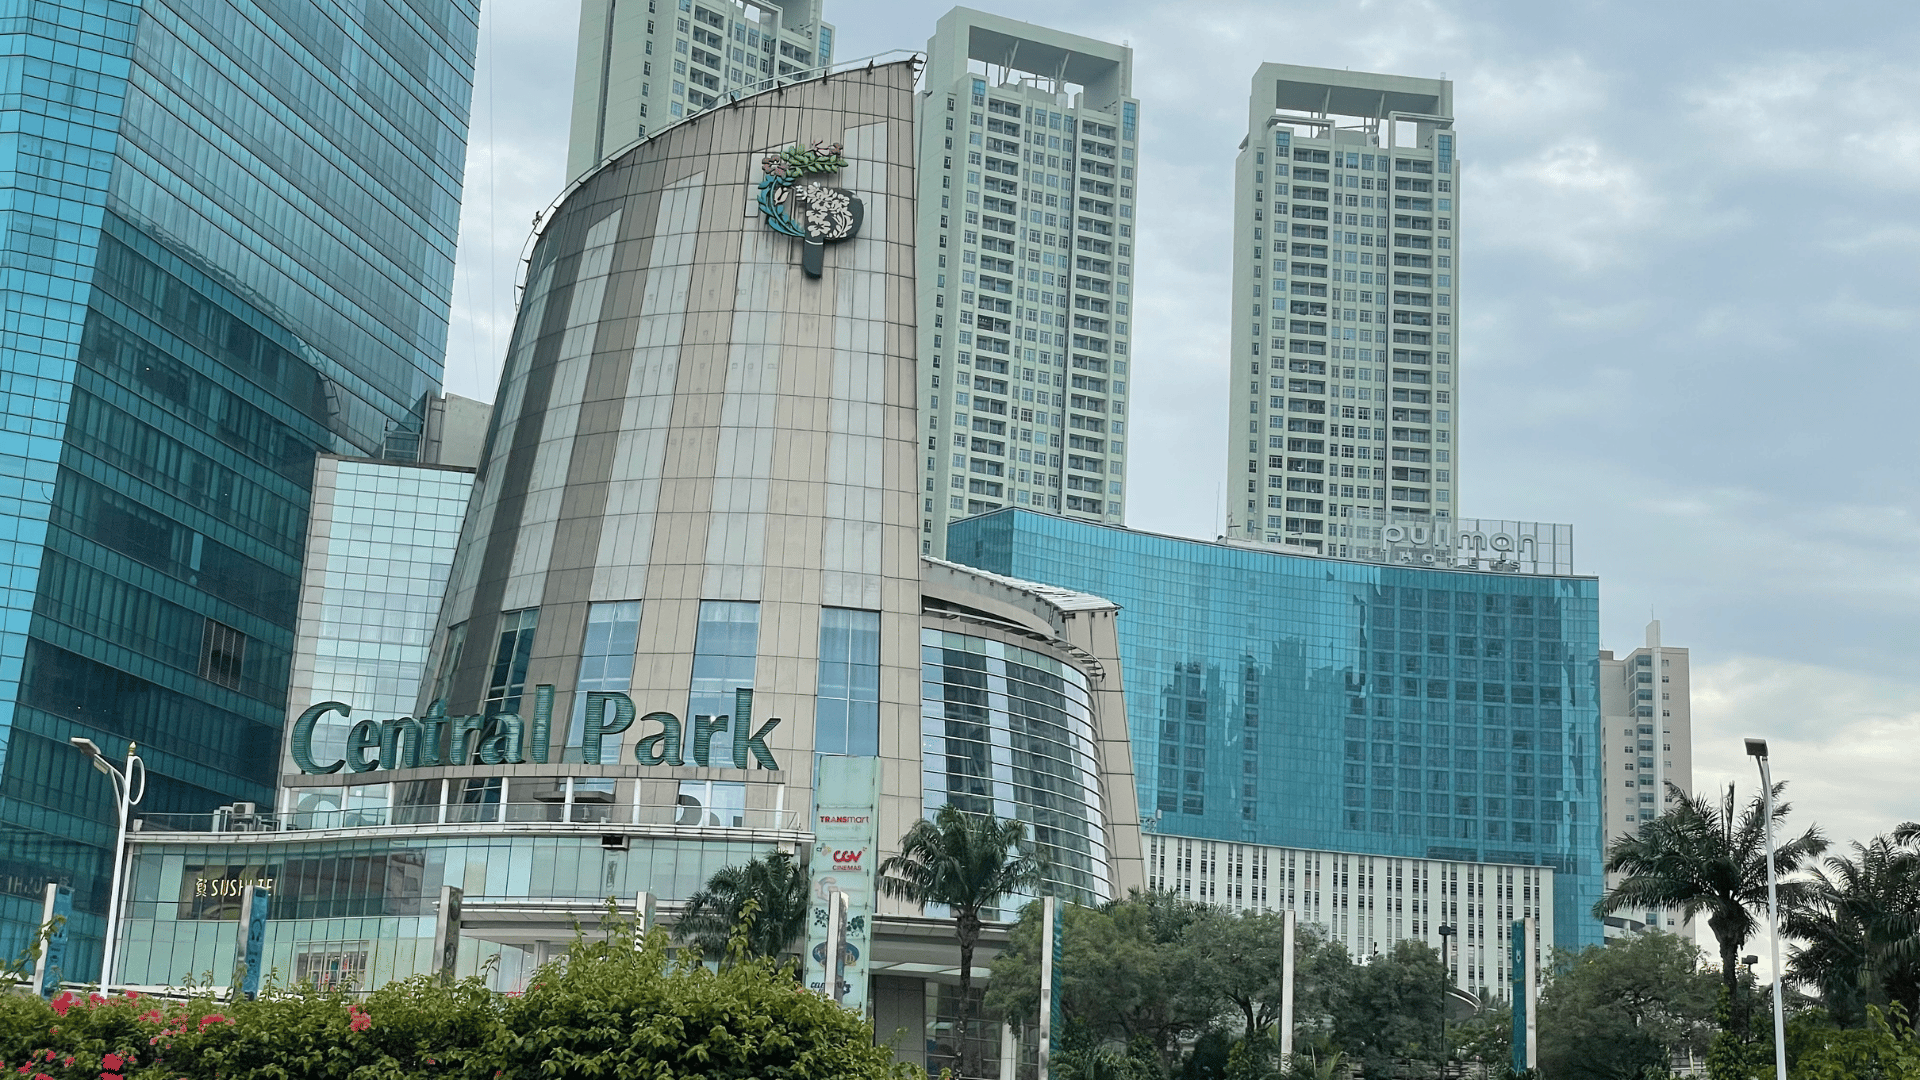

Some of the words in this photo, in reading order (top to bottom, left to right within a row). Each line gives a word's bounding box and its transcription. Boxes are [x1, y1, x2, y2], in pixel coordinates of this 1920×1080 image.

[1380, 523, 1538, 562] pullman
[290, 684, 555, 774] Central
[582, 687, 782, 771] Park
[833, 850, 862, 862] CGV
